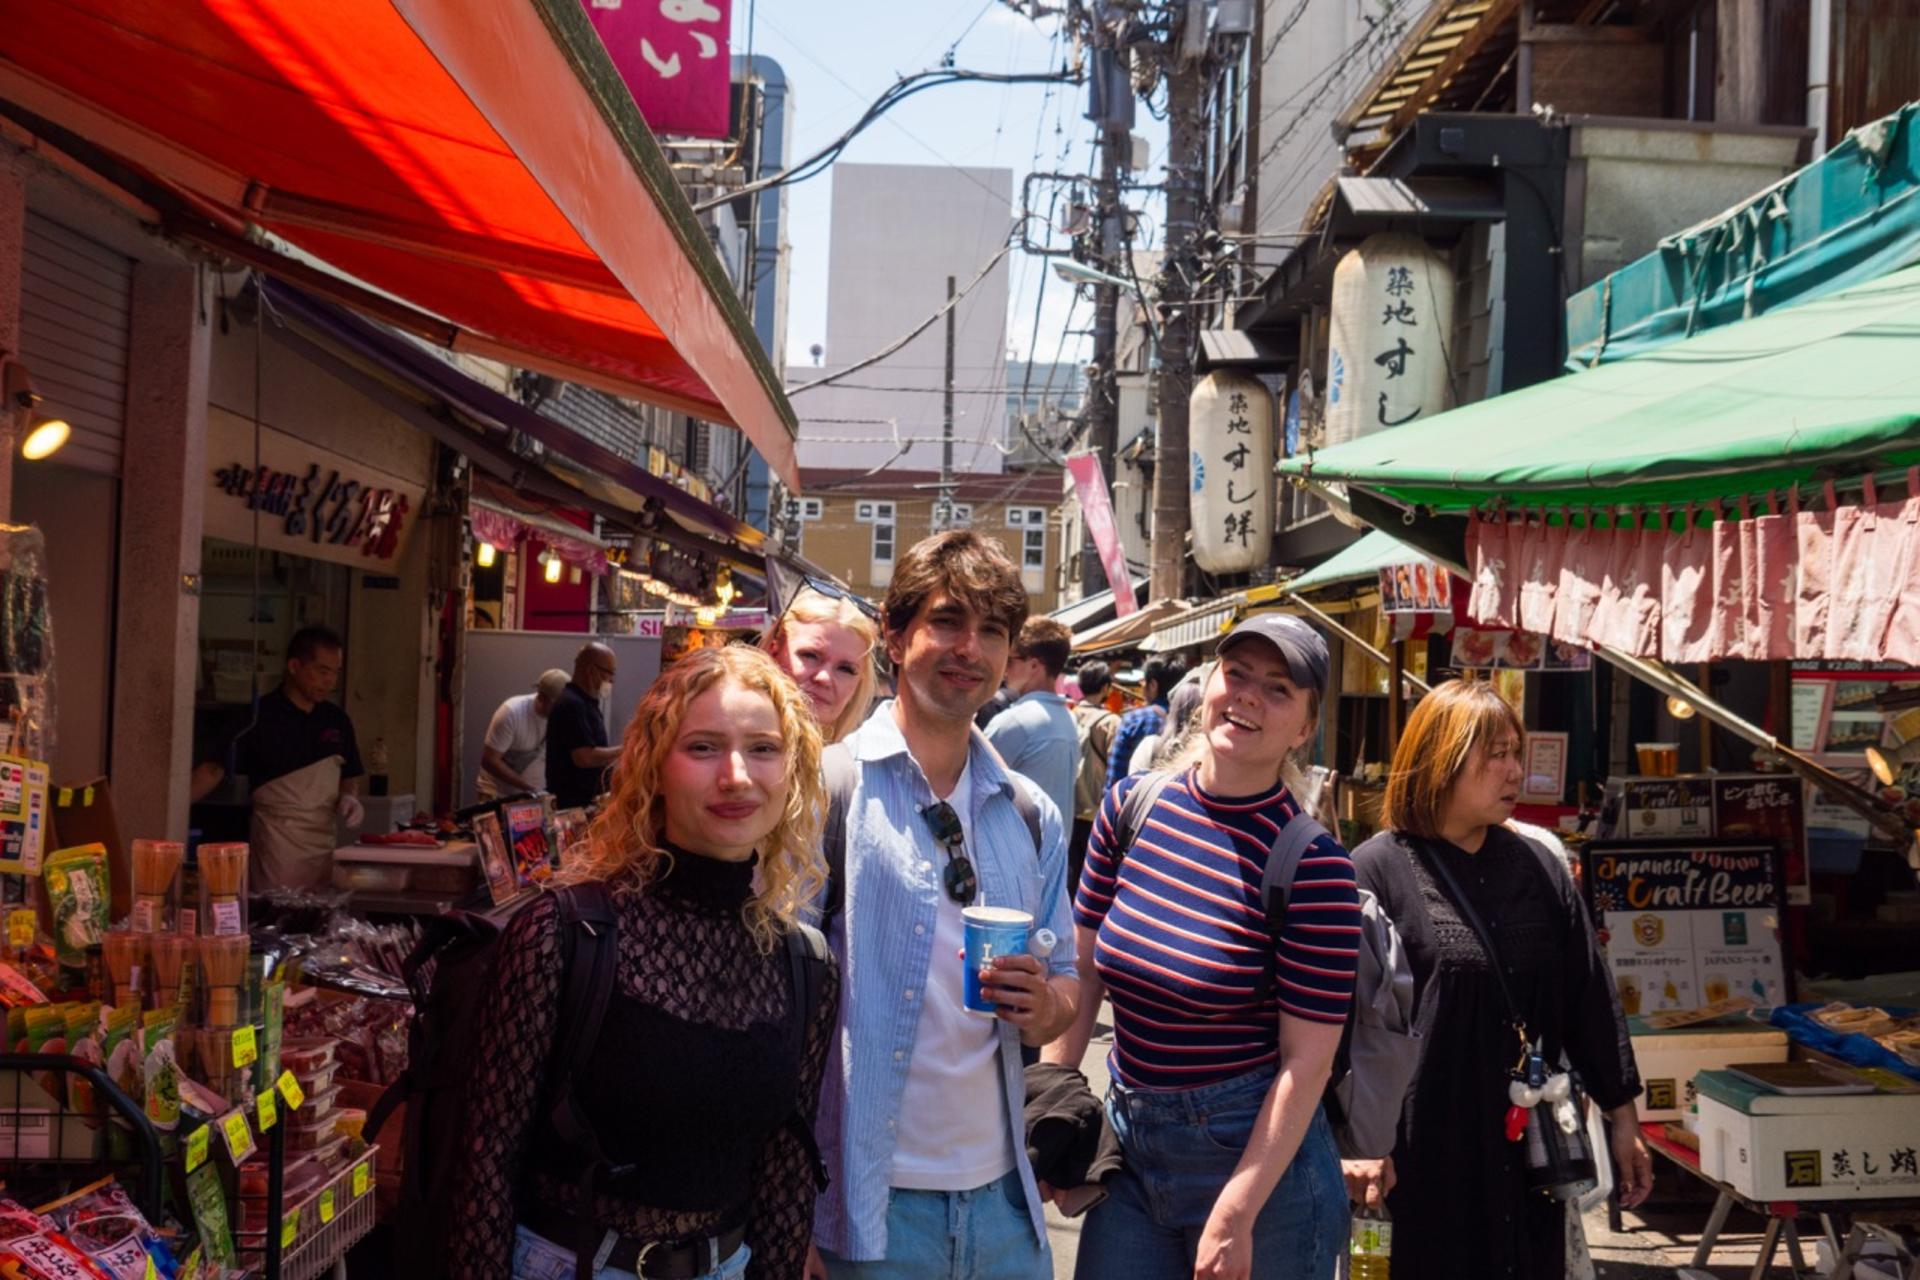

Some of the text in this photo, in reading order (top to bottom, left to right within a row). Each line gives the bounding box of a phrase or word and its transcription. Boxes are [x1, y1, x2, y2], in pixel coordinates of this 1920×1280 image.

[1373, 265, 1422, 427] 築地すし
[1223, 391, 1257, 549] 築地すし鮮
[1598, 856, 1690, 882] Japanese
[1627, 867, 1774, 909] Craft Beer
[1831, 1147, 1918, 1179] 蒸し蛸
